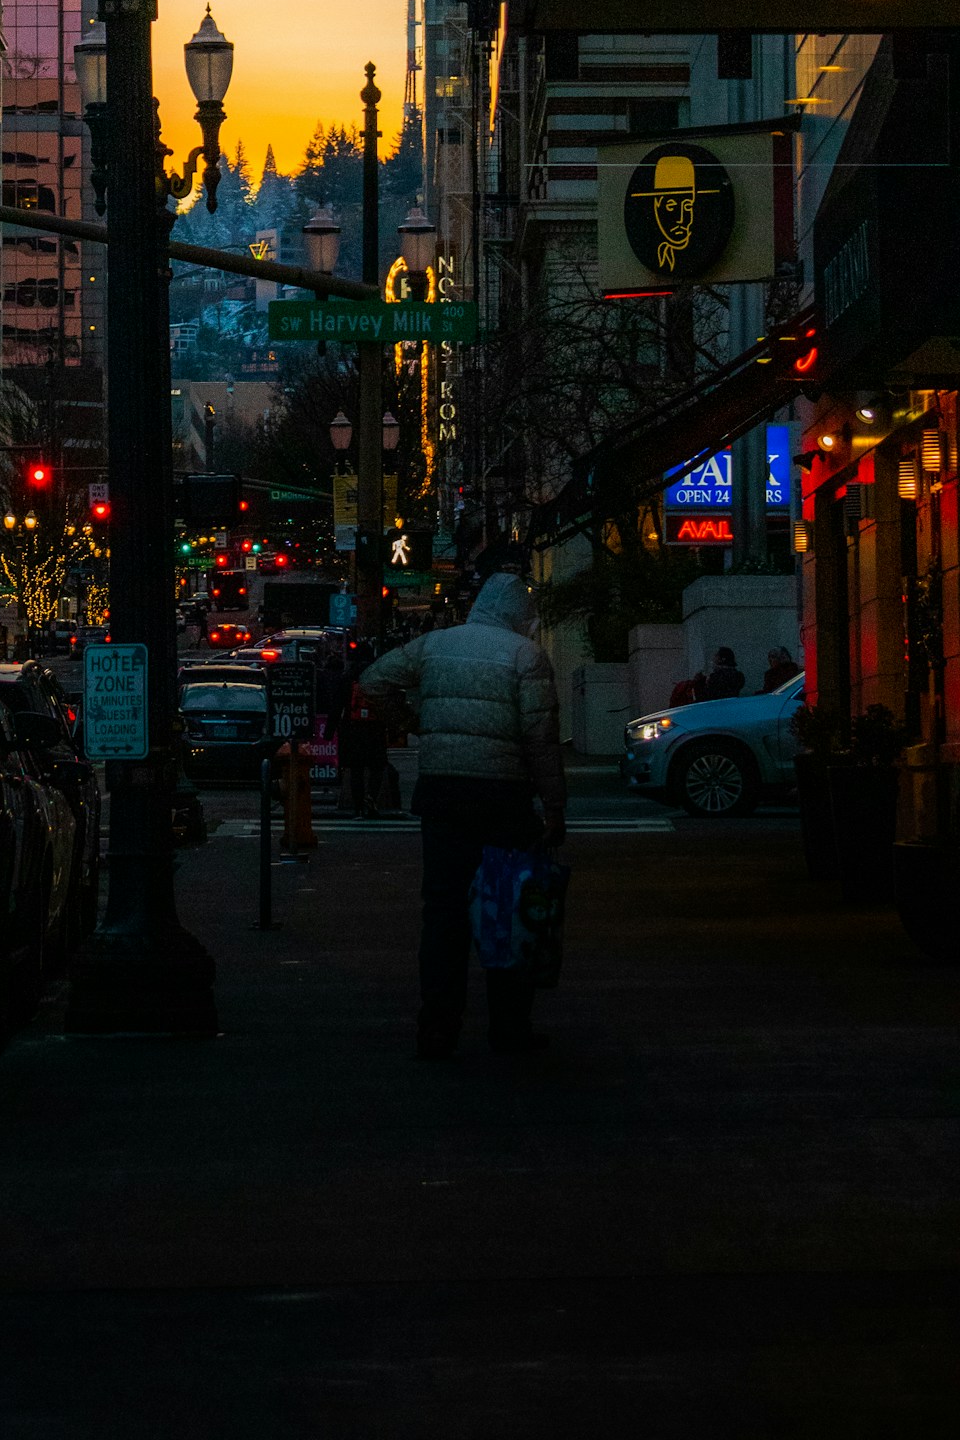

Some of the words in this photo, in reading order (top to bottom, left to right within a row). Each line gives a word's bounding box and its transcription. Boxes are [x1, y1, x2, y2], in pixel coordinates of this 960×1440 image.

[442, 306, 464, 318] 400
[280, 316, 303, 331] SW
[309, 310, 384, 337] Harvey
[393, 310, 432, 332] Milk
[442, 320, 453, 332] St
[676, 490, 712, 503] OPEN
[716, 489, 730, 503] 24
[91, 655, 140, 672] HOTEL
[95, 675, 135, 692] ZONE
[101, 695, 142, 706] MINUTES
[273, 702, 309, 714] Valet
[94, 723, 137, 735] LOADING
